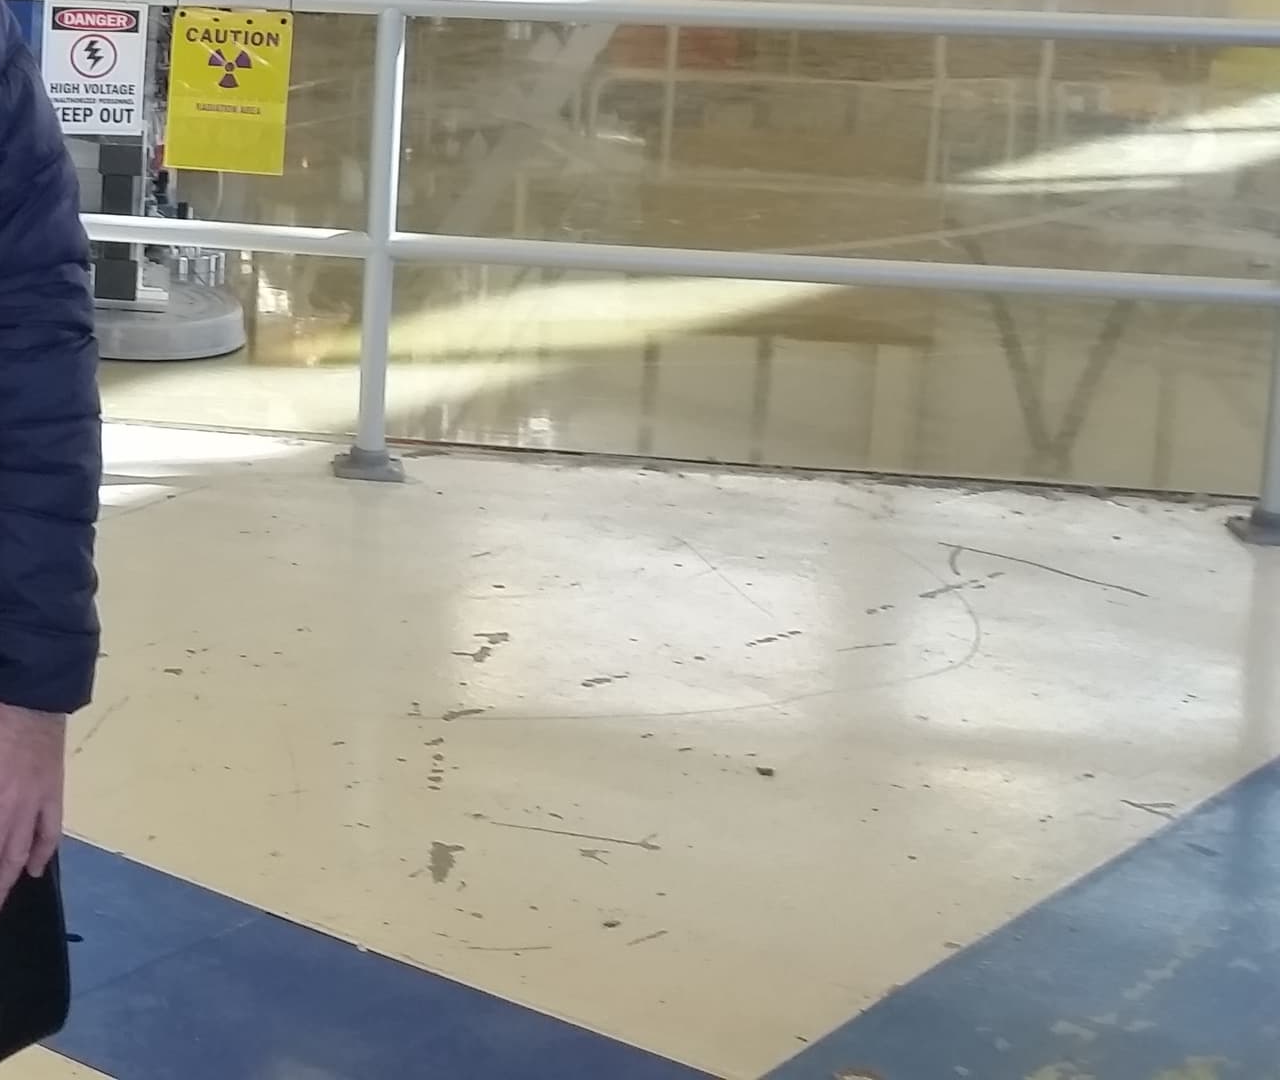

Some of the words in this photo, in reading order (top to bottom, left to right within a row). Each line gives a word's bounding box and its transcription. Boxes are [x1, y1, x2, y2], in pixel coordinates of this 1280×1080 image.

[63, 12, 129, 28] DANGER
[185, 27, 280, 47] CAUTION
[50, 83, 80, 95] HIGH
[84, 84, 136, 96] VOLTAGE
[100, 107, 135, 124] OUT
